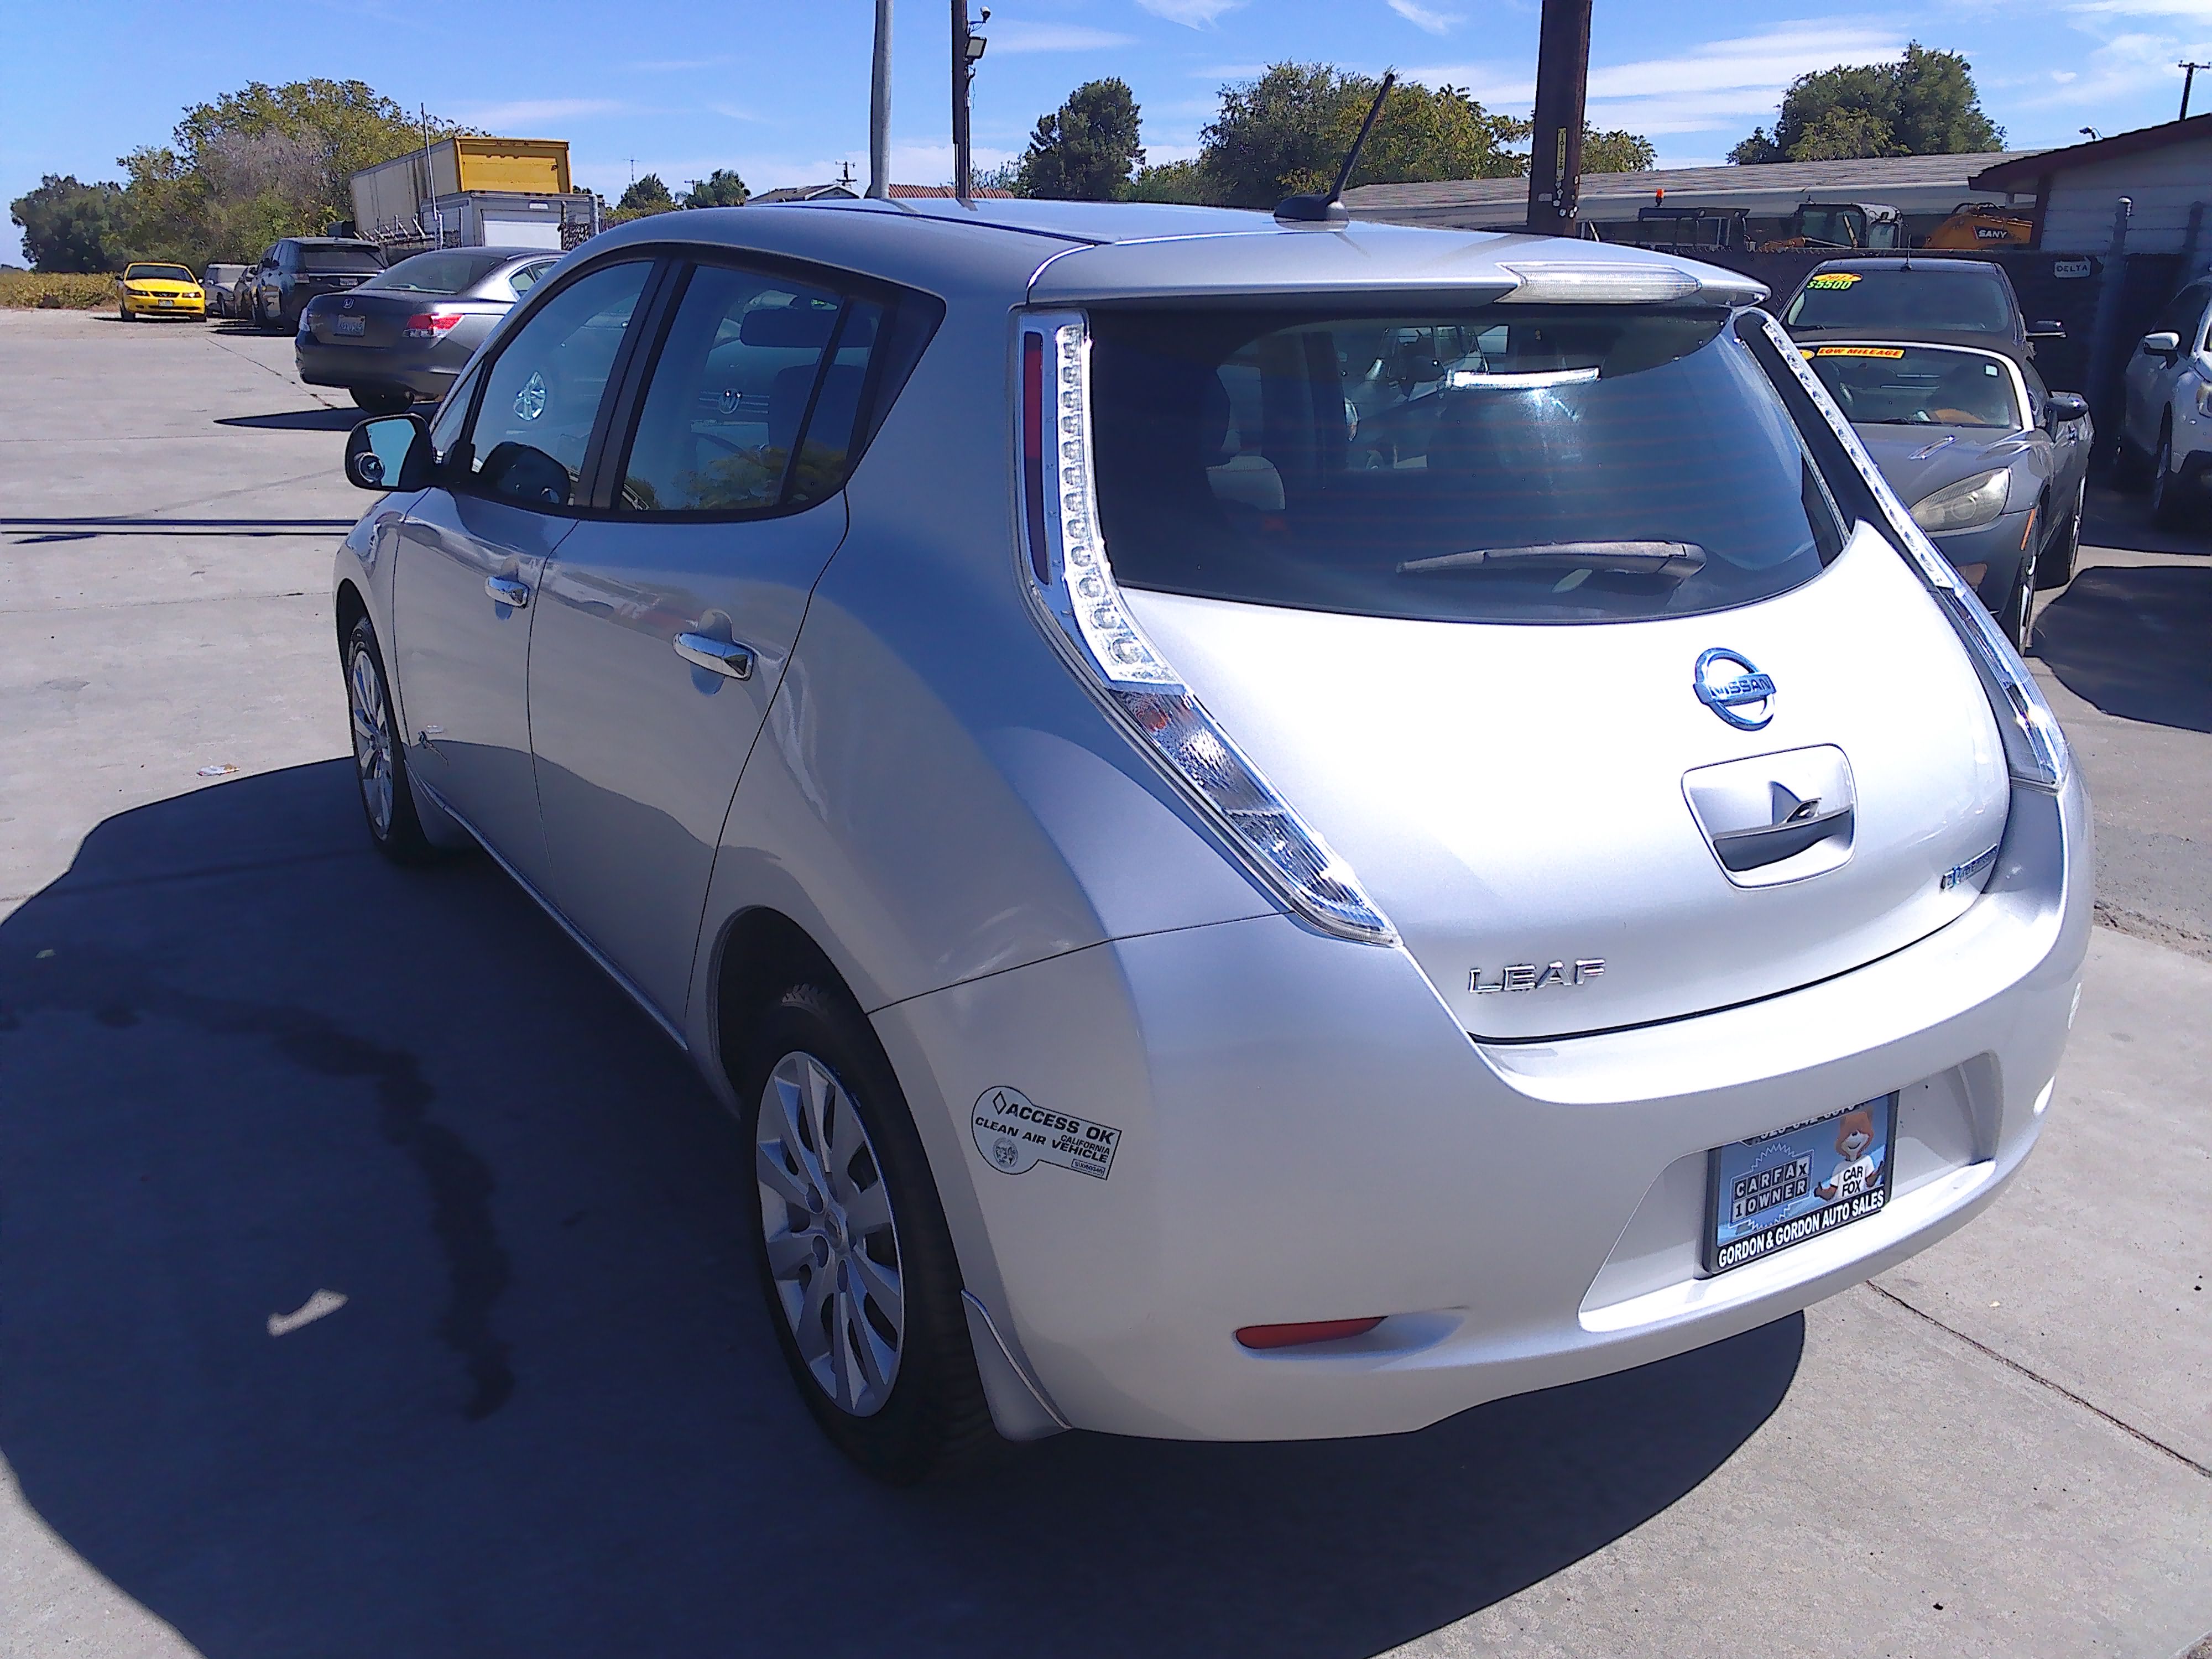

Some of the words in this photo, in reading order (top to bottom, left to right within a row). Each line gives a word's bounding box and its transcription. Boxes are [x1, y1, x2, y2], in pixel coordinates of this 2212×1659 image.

[1978, 229, 2007, 238] SANY
[1807, 280, 1853, 290] $5500
[1846, 348, 1902, 357] MILEAGE
[1708, 677, 1770, 697] NISSAN
[1469, 958, 1606, 994] LEAF
[1005, 1103, 1080, 1134] ACCESS
[1086, 1126, 1115, 1145] OK
[975, 1117, 1019, 1137] CLEAN
[1022, 1131, 1047, 1145] AIR
[1051, 1139, 1109, 1164] VEHICLE
[1060, 1134, 1110, 1155] CALIFORNIA
[1736, 1163, 1808, 1197] CARFAX
[1843, 1166, 1863, 1182] CAR
[1747, 1180, 1806, 1212] OWNER
[1842, 1180, 1861, 1197] FOX
[1718, 1233, 1765, 1267] GORDON
[1766, 1231, 1774, 1249] &
[1775, 1213, 1820, 1246] GORDON
[1822, 1202, 1850, 1228] AUTO
[1851, 1190, 1884, 1217] SALES
